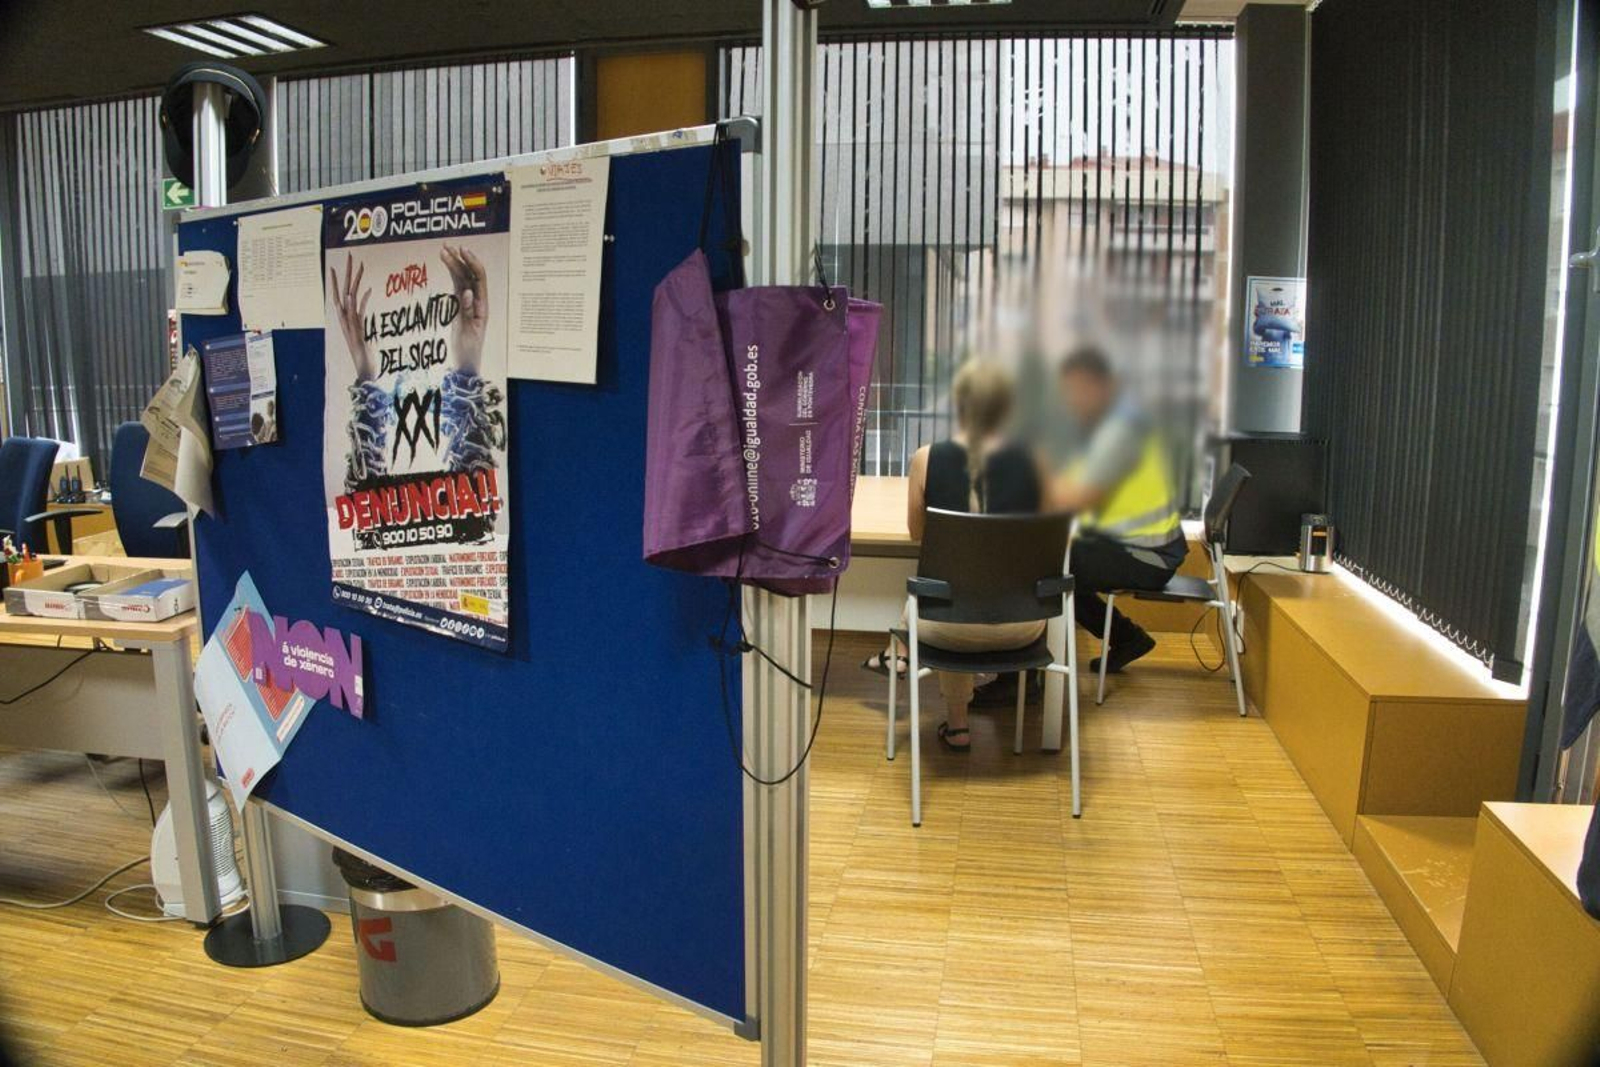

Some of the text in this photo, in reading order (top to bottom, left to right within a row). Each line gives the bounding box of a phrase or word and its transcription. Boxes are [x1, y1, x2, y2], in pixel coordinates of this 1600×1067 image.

[344, 195, 465, 241] 200 POLICIA
[390, 212, 486, 236] NACIONAL
[386, 261, 428, 298] CONTRA
[364, 292, 460, 342] LA ESCLAVITUD
[378, 338, 448, 379] DEL SIGLO
[391, 386, 442, 470] XXI
[335, 468, 502, 532] DENUNCIA!!
[382, 530, 405, 545] 900
[247, 611, 364, 719] NON
[284, 654, 335, 679] de xénero
[290, 645, 334, 667] violencia
